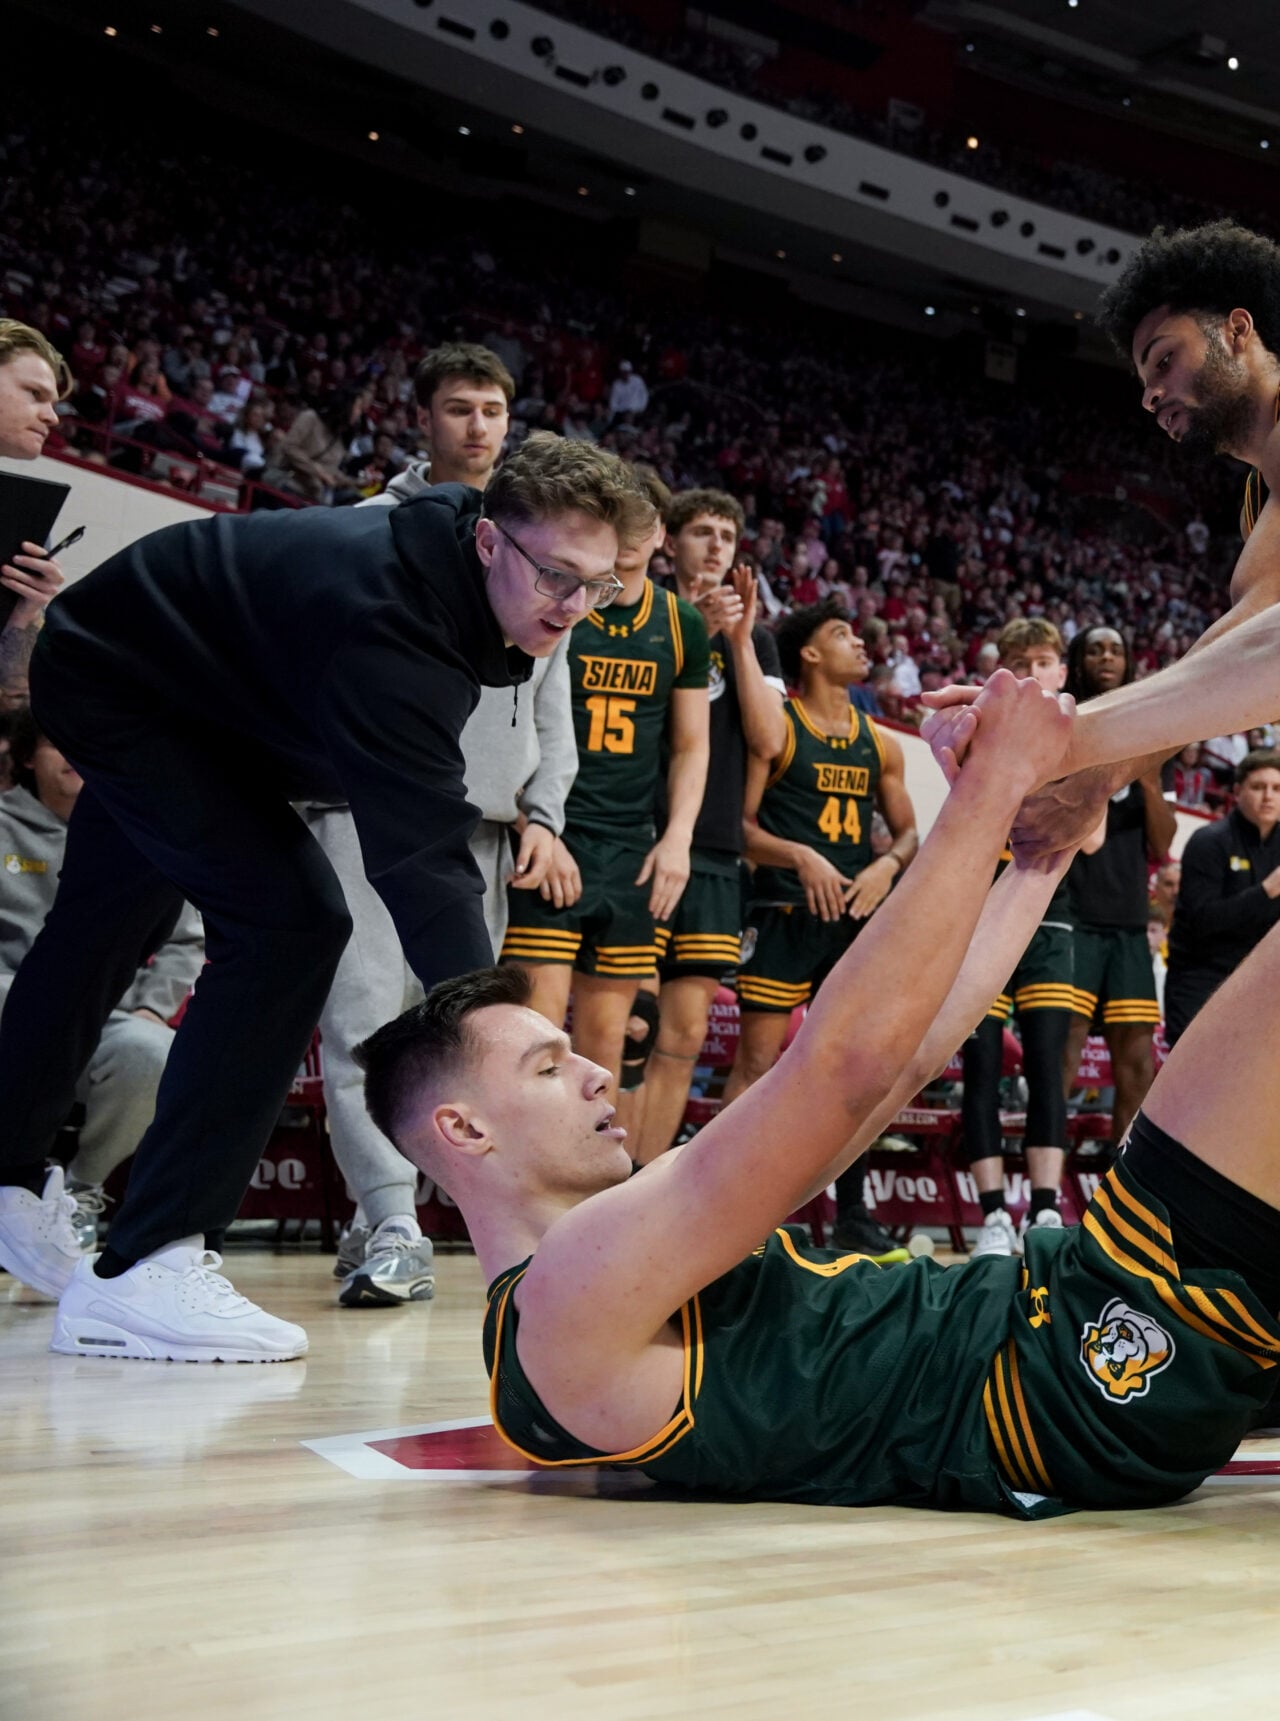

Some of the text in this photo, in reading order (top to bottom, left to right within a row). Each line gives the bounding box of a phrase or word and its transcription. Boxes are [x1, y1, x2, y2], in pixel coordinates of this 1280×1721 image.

[585, 660, 655, 693] SIENA
[585, 694, 637, 755] 15
[820, 766, 868, 794] SIENA
[817, 796, 862, 845] 44
